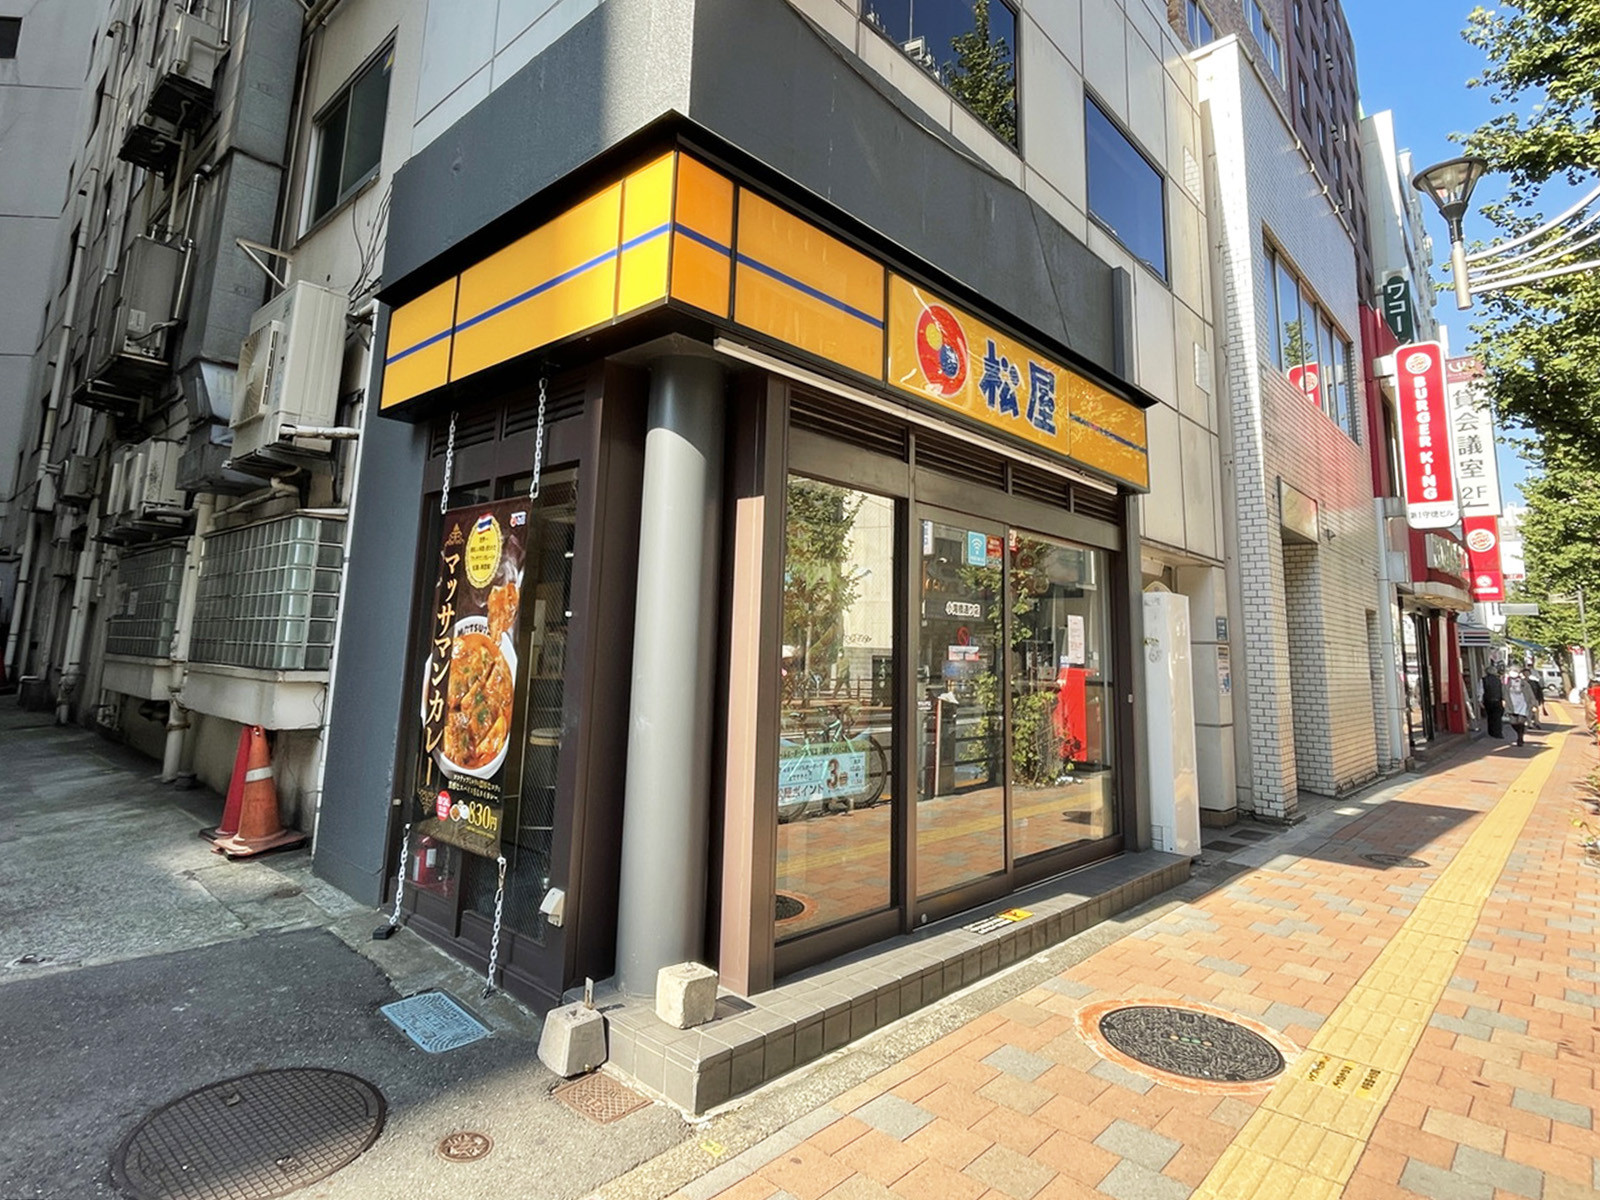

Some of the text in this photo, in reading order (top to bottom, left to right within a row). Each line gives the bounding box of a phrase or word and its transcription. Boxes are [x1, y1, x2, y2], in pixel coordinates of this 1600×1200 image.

[978, 338, 1057, 437] 松屋
[1413, 376, 1432, 448] BURGER
[1452, 387, 1486, 480] 貸会議室
[1419, 450, 1438, 500] KING
[1461, 485, 1488, 500] 2F
[425, 552, 461, 786] マッサマンカレー
[468, 800, 498, 831] 830円
